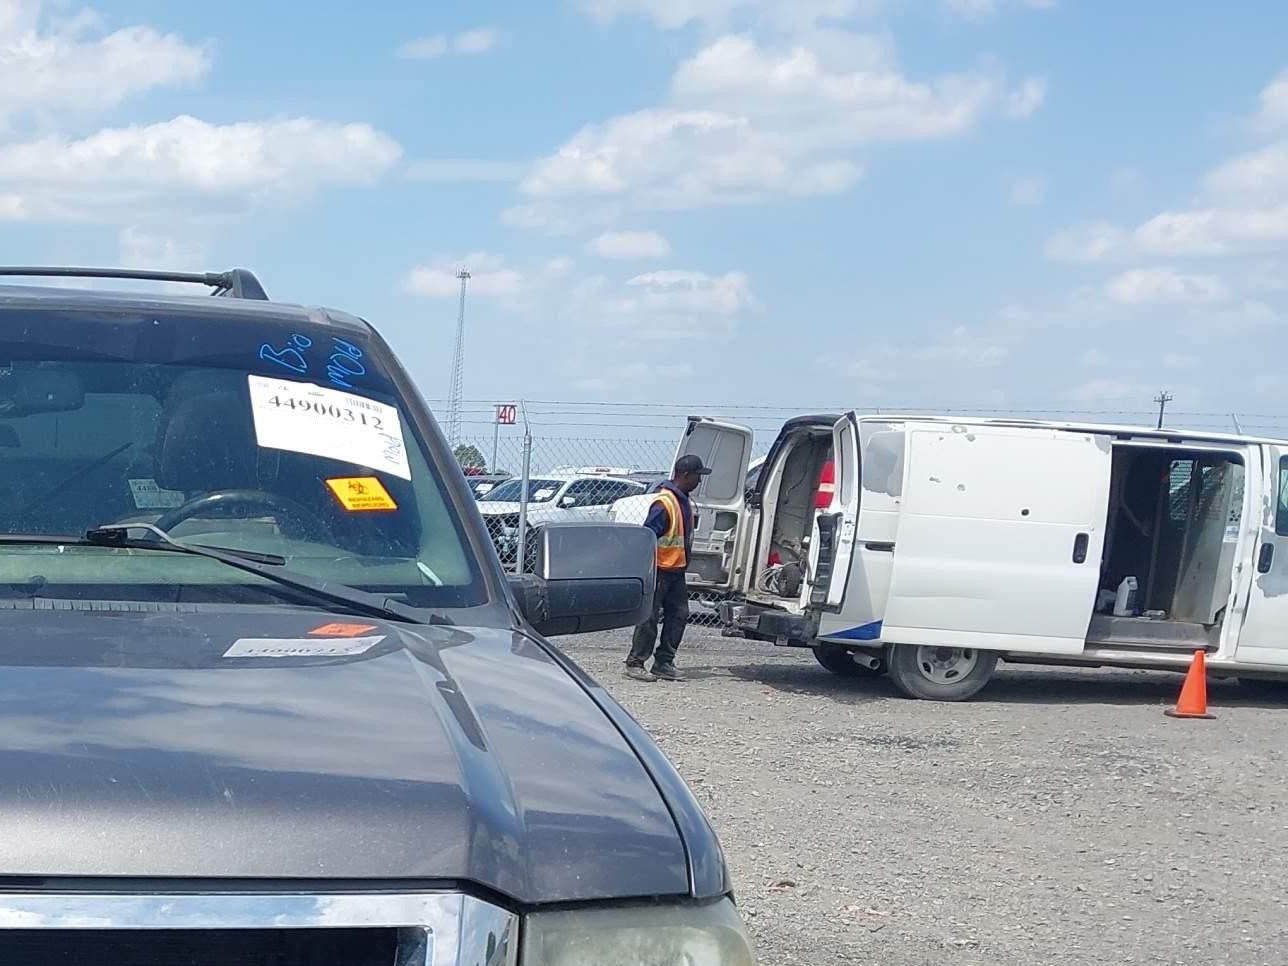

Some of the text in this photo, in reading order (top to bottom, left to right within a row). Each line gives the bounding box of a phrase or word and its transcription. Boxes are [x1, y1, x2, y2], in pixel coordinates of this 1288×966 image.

[259, 333, 312, 374] Bio
[268, 394, 385, 431] 44900312
[499, 405, 517, 424] 40
